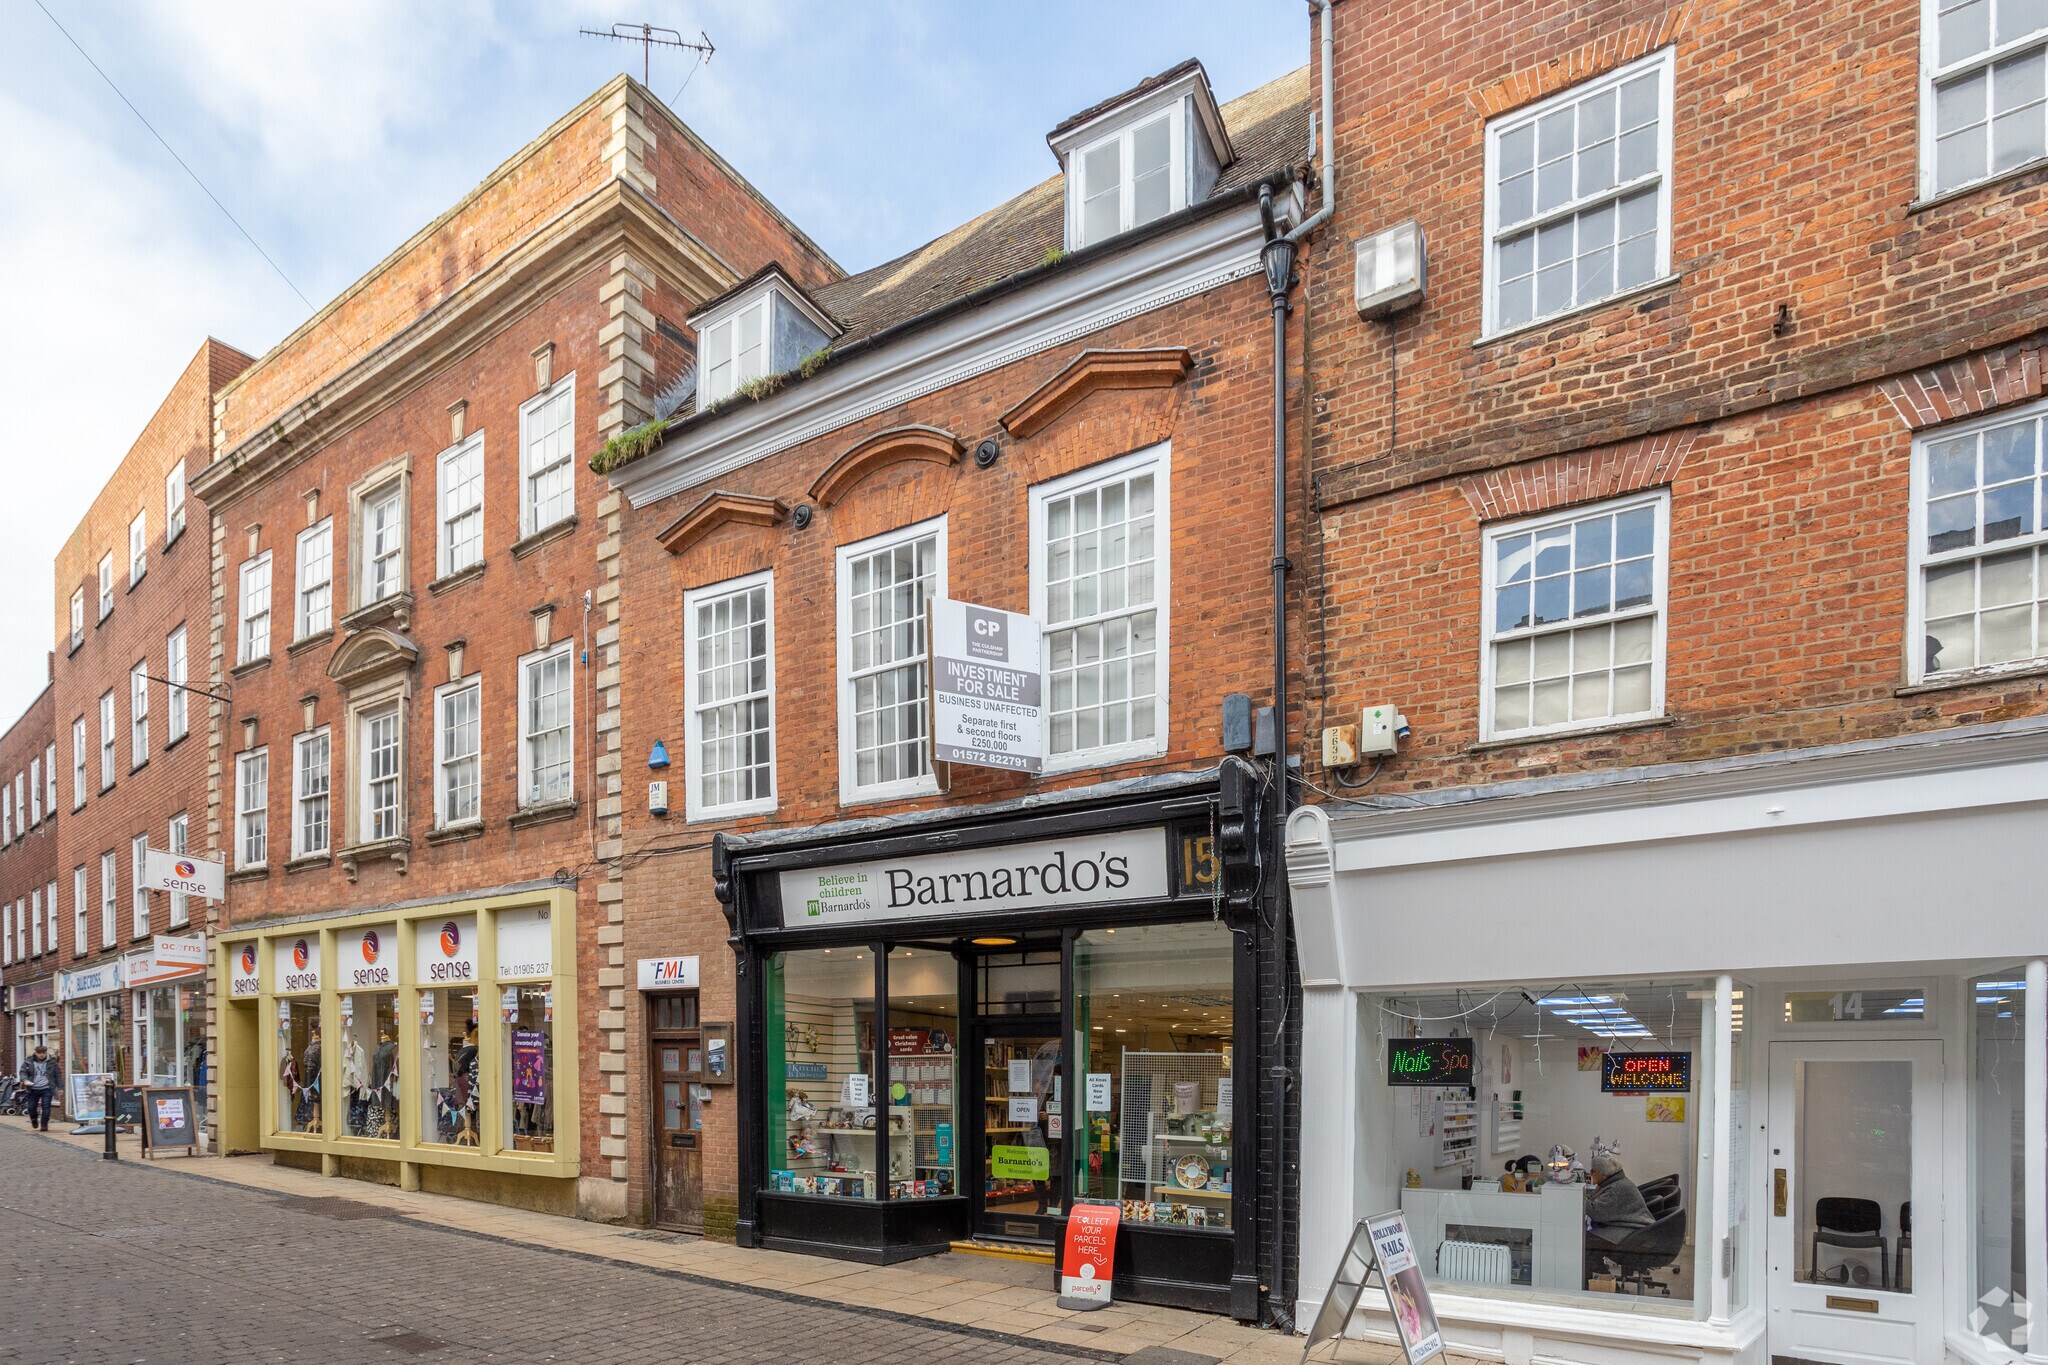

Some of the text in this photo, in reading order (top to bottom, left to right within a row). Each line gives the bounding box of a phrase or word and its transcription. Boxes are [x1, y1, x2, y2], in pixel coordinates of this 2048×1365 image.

[974, 619, 1000, 637] CP
[972, 648, 1004, 657] PARTNERSHIP
[982, 643, 1004, 652] CULSHAW
[948, 662, 1027, 688] INVESTMENT
[957, 680, 1019, 701] FOR SALE
[939, 694, 1038, 718] BUSINESS UNAFFECTED
[962, 714, 1017, 731] Separate first
[957, 724, 1022, 742] & second floors
[972, 738, 1008, 752] £250,000
[952, 749, 1028, 768] 01572 822791
[650, 782, 660, 793] JM
[1184, 838, 1221, 885] 15
[163, 876, 206, 894] sense
[818, 873, 869, 888] Believe in
[885, 851, 1130, 908] Barnardo's
[819, 885, 862, 899] children
[820, 898, 871, 914] Barnardo's
[538, 910, 549, 920] No
[161, 942, 201, 952] acrns
[354, 966, 389, 985] sense
[430, 960, 471, 980] sense
[500, 963, 550, 976] Tel: 01905 237
[654, 960, 684, 979] FML
[286, 972, 318, 990] sense
[1828, 993, 1864, 1020] 14
[1392, 1050, 1469, 1074] Nails Spa
[1625, 1060, 1670, 1072] OPEN
[1612, 1073, 1682, 1086] WELCOME
[998, 1156, 1042, 1167] Barnardo's
[1076, 1216, 1110, 1226] COLLECT
[1081, 1226, 1102, 1235] YOUR
[1372, 1223, 1403, 1240] HOLLYWOOD
[1074, 1234, 1106, 1245] PARCELS
[1078, 1246, 1098, 1254] HERE
[1381, 1238, 1404, 1258] NAILS
[1072, 1284, 1097, 1295] parcelly
